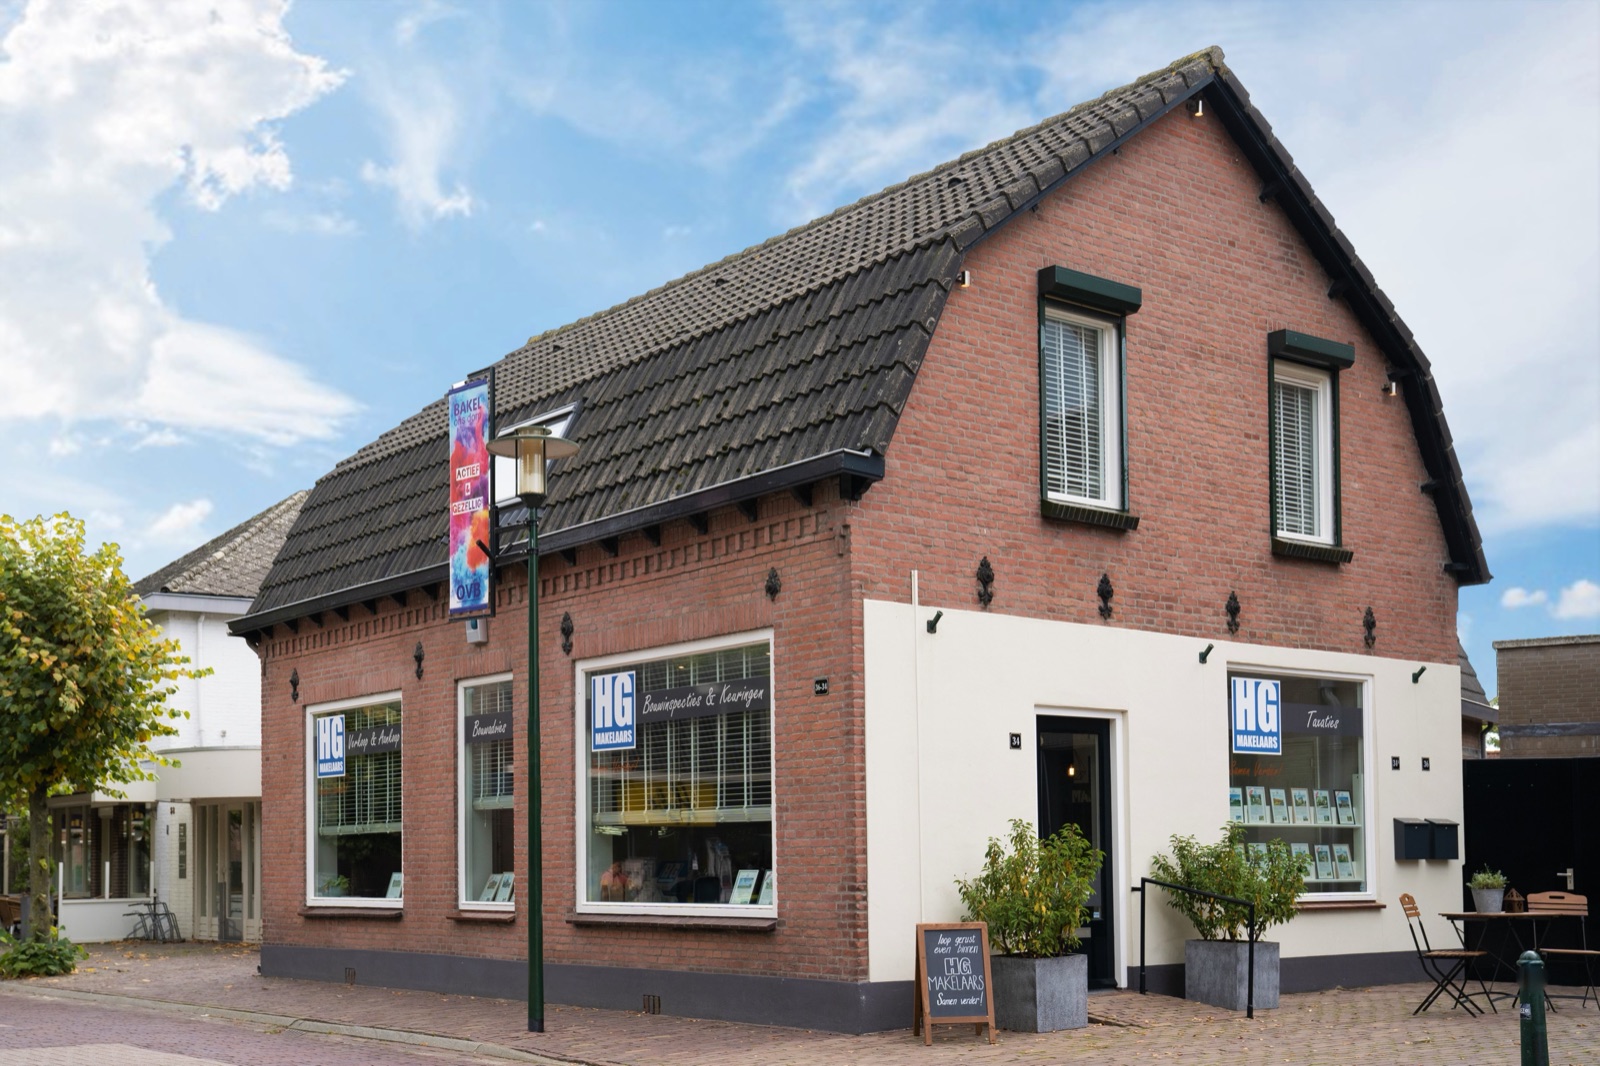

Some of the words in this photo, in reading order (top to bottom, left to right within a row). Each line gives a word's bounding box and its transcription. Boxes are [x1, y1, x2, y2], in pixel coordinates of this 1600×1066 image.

[453, 396, 482, 417] BAKEL
[456, 464, 480, 479] ACTIEF
[456, 581, 481, 600] OVB
[595, 674, 632, 728] HG
[642, 692, 702, 717] Bouwinspecties
[705, 687, 716, 706] &
[719, 684, 765, 708] Keuringen
[1236, 680, 1277, 732] HG
[1306, 710, 1340, 729] Taxaties
[319, 716, 343, 760] HG
[348, 733, 369, 752] Verkoop
[370, 731, 377, 746] &
[378, 728, 400, 748] Aankoop
[595, 729, 632, 745] MAKELAARS
[1012, 736, 1020, 746] 34
[1236, 734, 1278, 749] MAKELAARS
[319, 761, 344, 773] MAKELAARS
[938, 933, 951, 946] loop
[955, 935, 976, 946] gerust
[933, 946, 951, 954] even
[957, 944, 979, 954] binnen
[944, 957, 972, 975] HG
[927, 974, 985, 991] MAKELAARS
[937, 992, 957, 1006] Samen
